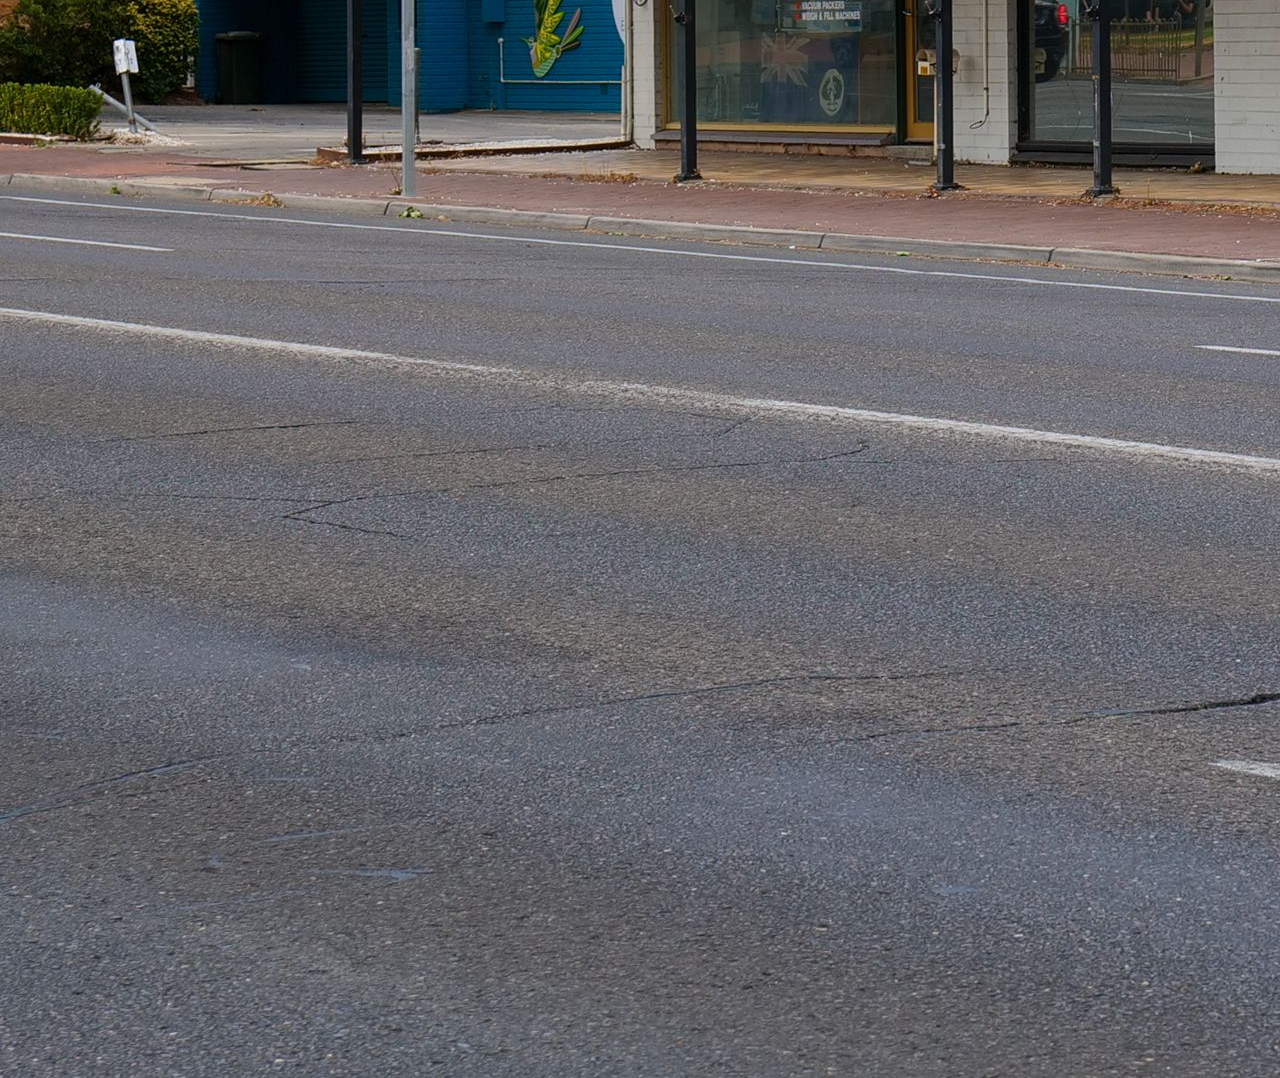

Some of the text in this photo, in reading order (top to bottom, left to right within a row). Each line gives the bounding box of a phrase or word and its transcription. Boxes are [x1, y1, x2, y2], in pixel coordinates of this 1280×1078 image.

[801, 1, 845, 10] VACUUM PACKERS
[801, 12, 818, 21] WEIGH
[824, 11, 834, 20] FILL
[835, 10, 861, 20] MACHINES
